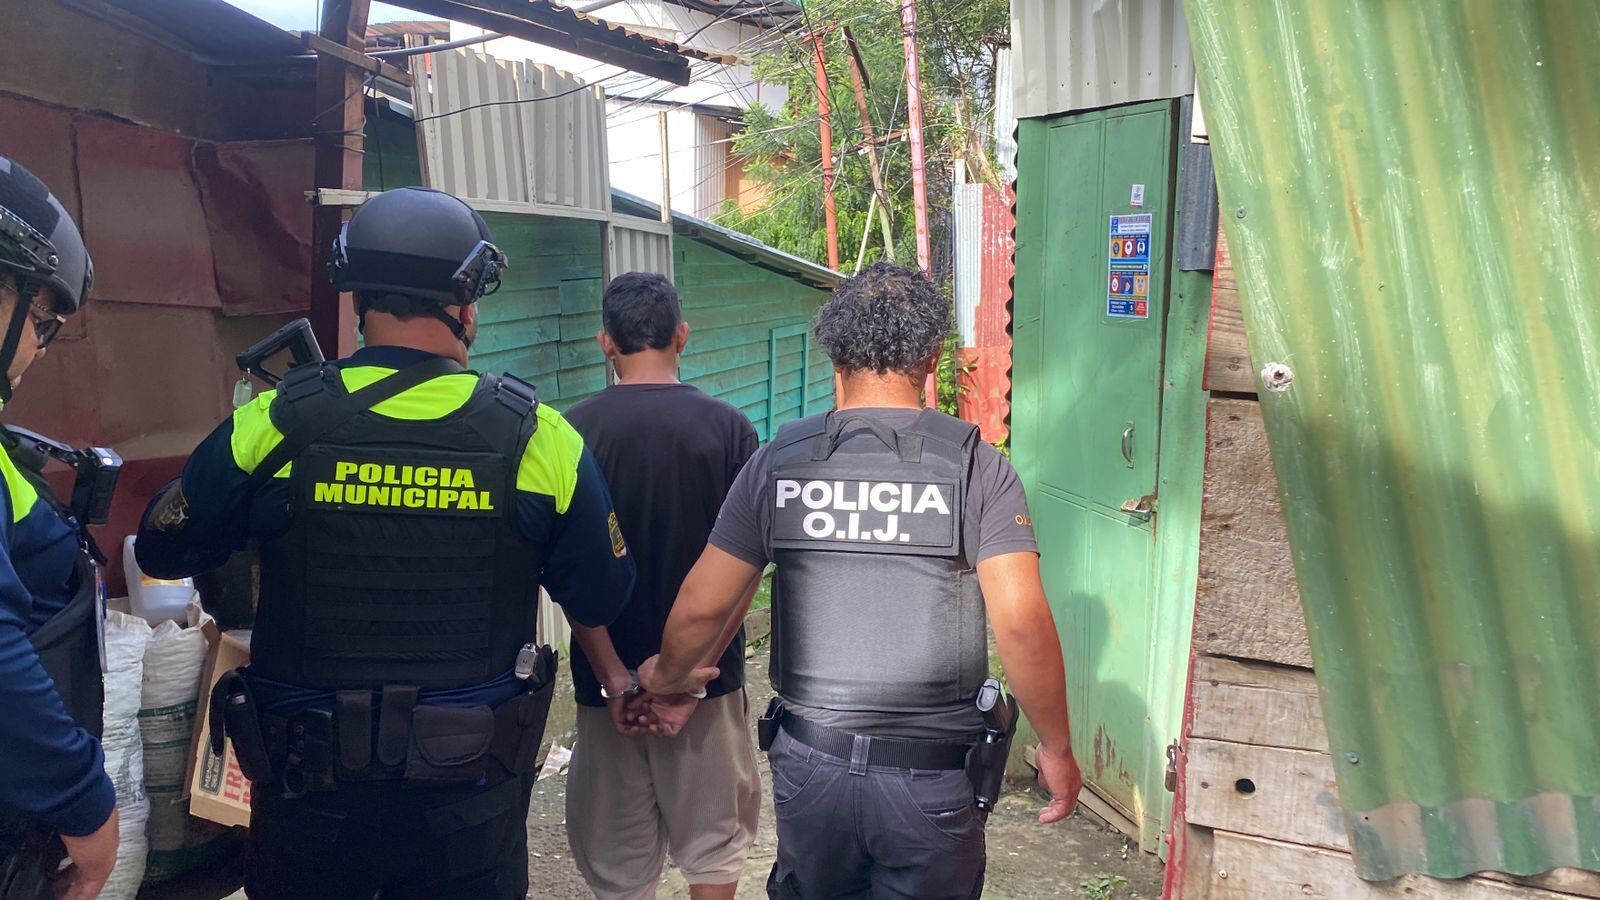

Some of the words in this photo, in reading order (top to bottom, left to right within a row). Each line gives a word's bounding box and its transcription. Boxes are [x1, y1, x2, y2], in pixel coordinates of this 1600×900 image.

[335, 461, 475, 488] POLICIA
[314, 482, 494, 510] MUNICIPAL
[776, 479, 950, 515] POLICIA
[802, 511, 910, 542] O.I.J.
